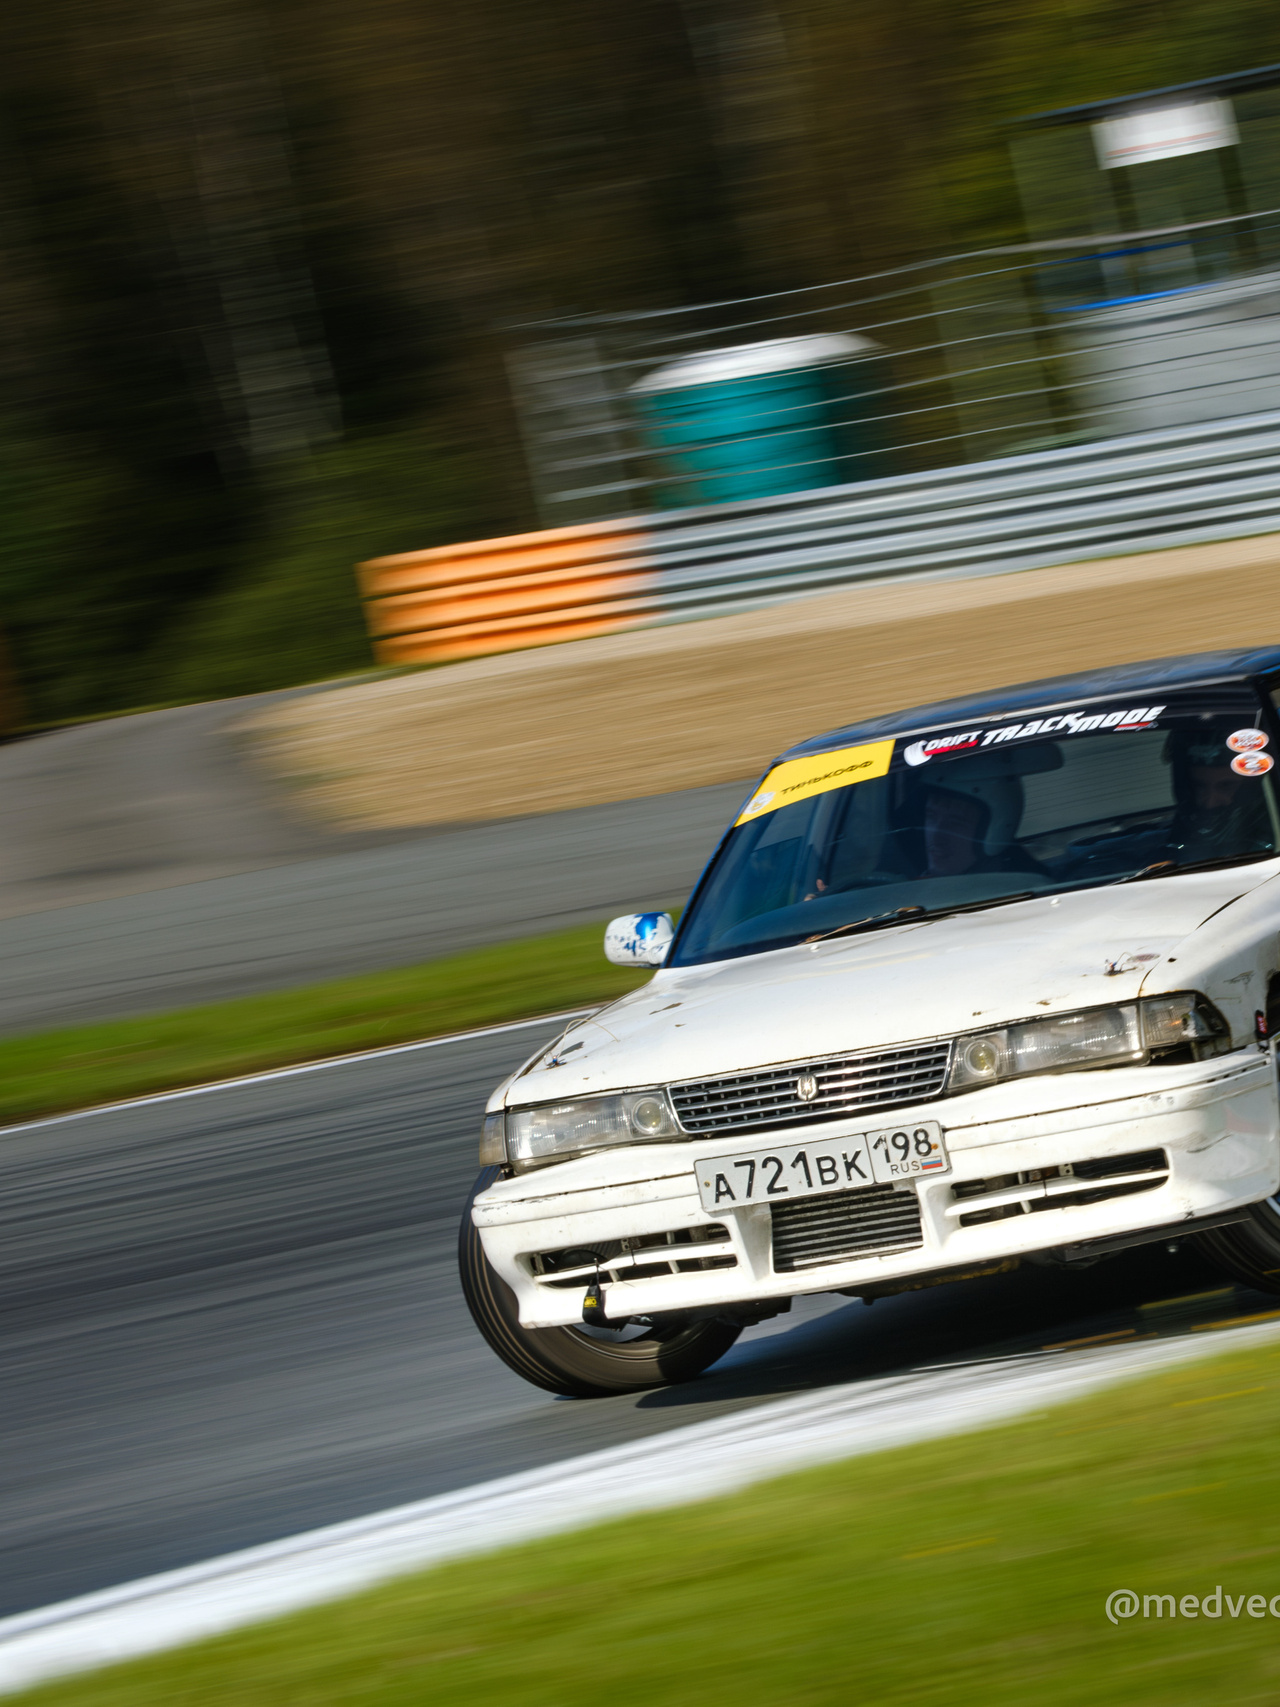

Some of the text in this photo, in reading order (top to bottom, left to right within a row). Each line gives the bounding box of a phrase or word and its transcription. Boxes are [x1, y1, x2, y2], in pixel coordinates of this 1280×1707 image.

[924, 730, 984, 752] DRIFT
[780, 760, 875, 795] ТИНЬКОФФ
[872, 1127, 933, 1164] 198
[890, 1159, 921, 1176] RUS
